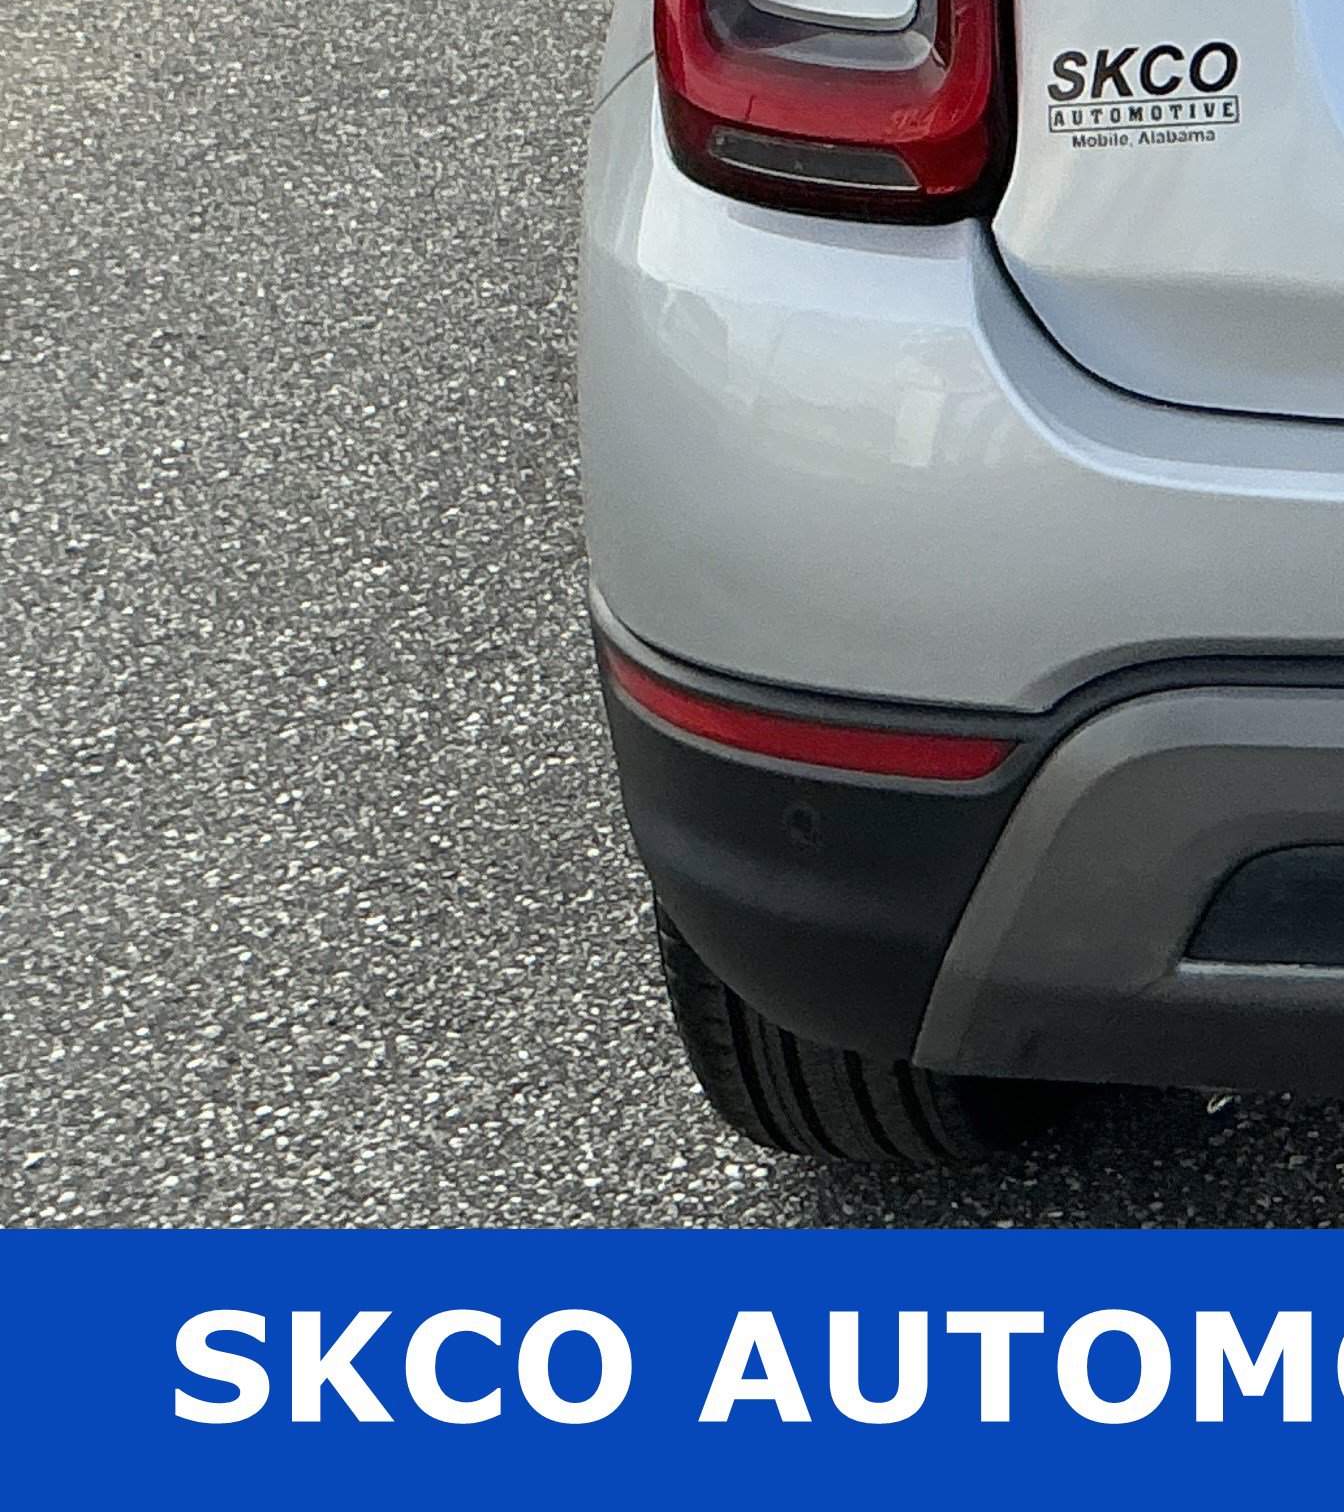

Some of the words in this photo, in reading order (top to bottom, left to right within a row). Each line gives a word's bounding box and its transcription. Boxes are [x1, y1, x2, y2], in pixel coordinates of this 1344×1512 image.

[1047, 41, 1238, 102] SKCO
[1053, 102, 1234, 127] AUTOMOTIVE
[1072, 131, 1134, 148] Mobile,
[1138, 129, 1216, 145] Alabama
